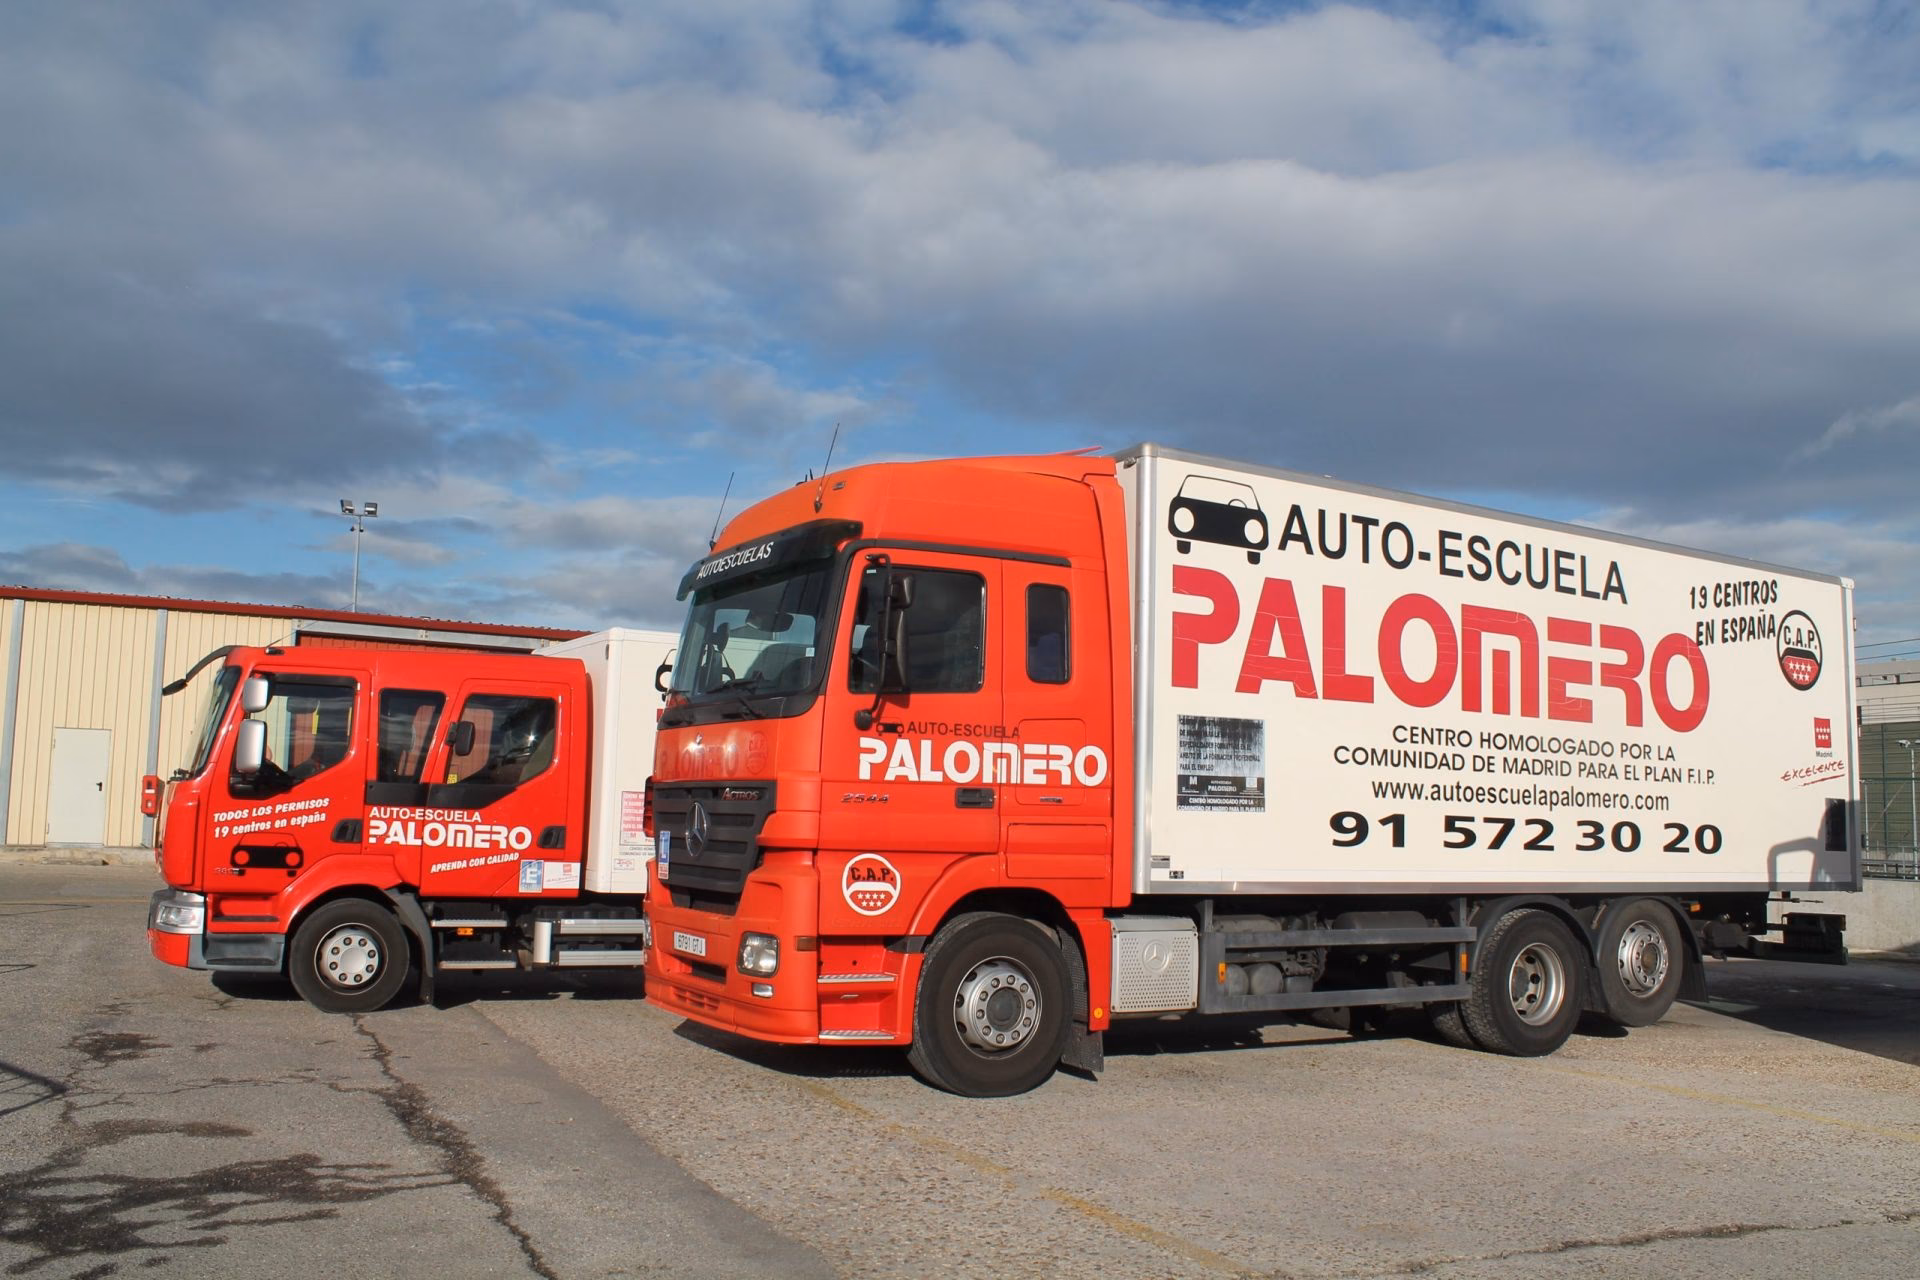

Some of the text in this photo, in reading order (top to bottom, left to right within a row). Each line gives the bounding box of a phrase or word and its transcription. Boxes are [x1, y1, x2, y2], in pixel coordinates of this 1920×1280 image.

[696, 541, 775, 580] AUTOESCUELAS
[1277, 503, 1628, 605] AUTO-ESCUELA
[1690, 579, 1778, 610] 19 CENTROS
[1696, 609, 1776, 646] EN ESPAÑA
[1783, 625, 1818, 650] C.A.P.
[1171, 564, 1710, 733] PALOMERO
[906, 721, 1020, 739] AUTO-ESCUELA
[1392, 725, 1675, 762] CENTRO HOMOLOGADO POR LA
[858, 736, 1108, 787] PALOMERO
[1334, 745, 1715, 785] COMUNIDAD DE MADRID PARA EL PLAN F.I.P.
[1815, 750, 1833, 758] Madrid
[1781, 760, 1844, 781] EXCELENTE
[213, 797, 330, 822] TODOS LOS PERMISOS
[840, 793, 889, 804] 2544
[1372, 780, 1669, 812] www.autoescuelapalomero.com
[214, 811, 326, 838] 19 centros en españa
[369, 806, 482, 823] AUTO-ESCUELA
[368, 819, 532, 850] PALOMERO
[1329, 811, 1723, 854] 91 572 30 20
[430, 852, 520, 874] APRENDA CON CALIDAD
[851, 867, 894, 881] C.A.P.
